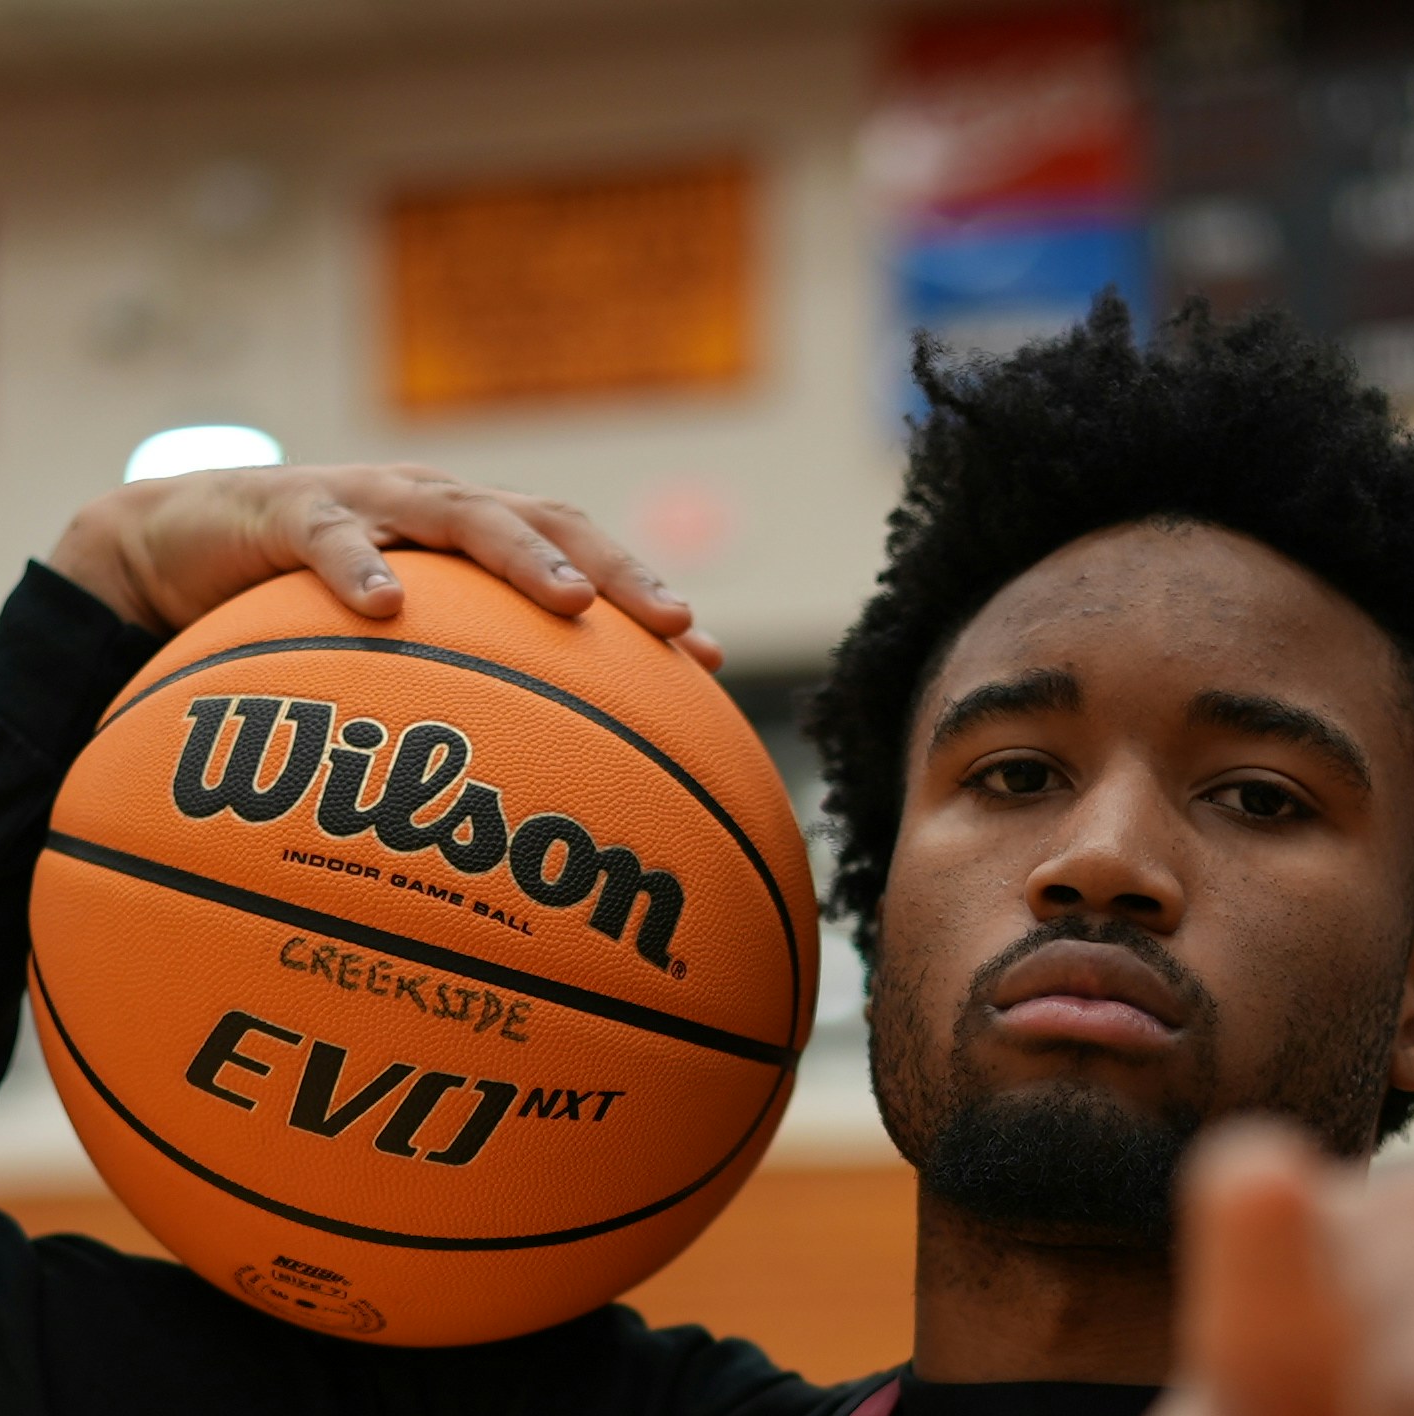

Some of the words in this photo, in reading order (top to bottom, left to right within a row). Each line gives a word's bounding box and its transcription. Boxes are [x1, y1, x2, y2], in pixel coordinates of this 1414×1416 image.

[282, 849, 382, 881] INDOOR
[390, 873, 466, 908] GAME
[472, 900, 534, 937] BALL
[279, 936, 534, 1043] CREEKSIDE
[185, 1009, 520, 1167] EVO
[517, 1087, 625, 1122] NXT
